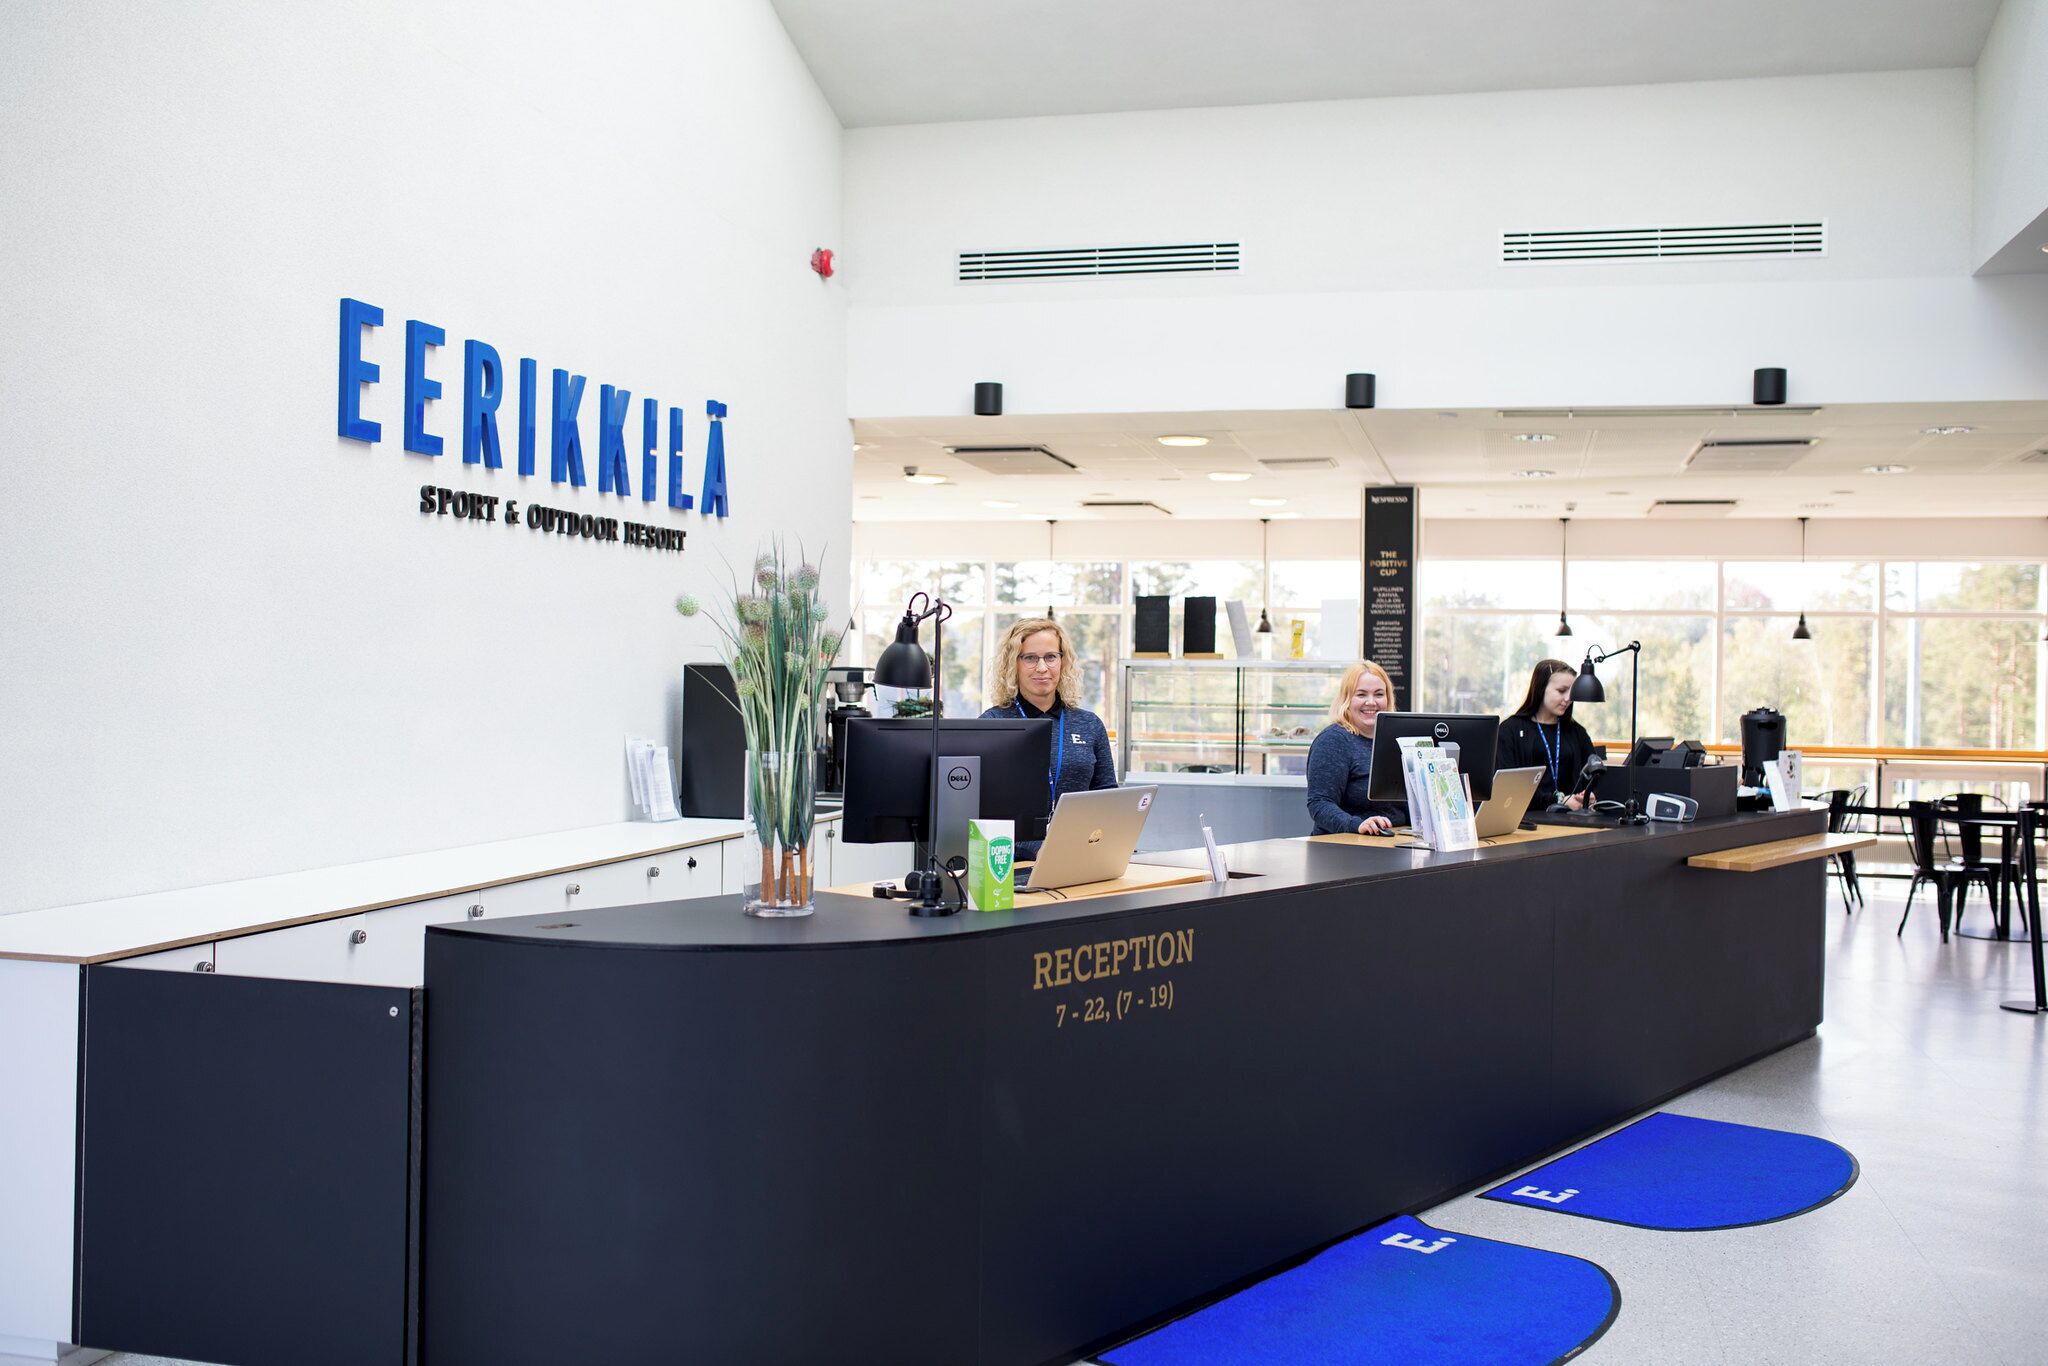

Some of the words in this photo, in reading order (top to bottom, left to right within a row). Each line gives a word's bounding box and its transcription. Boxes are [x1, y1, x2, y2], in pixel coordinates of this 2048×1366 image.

[338, 297, 729, 517] EERIKKILÄ
[1371, 496, 1408, 504] NESPRESSO
[420, 485, 499, 522] SPORT
[505, 500, 520, 524] &
[527, 503, 619, 543] OUTDOOR
[623, 521, 687, 551] RESORT
[1380, 551, 1397, 559] THE
[991, 845, 1011, 856] DOPING
[995, 855, 1007, 865] FREE
[1033, 928, 1194, 990] RECEPTION
[1056, 1004, 1067, 1028] 7
[1084, 996, 1110, 1023] 22,
[1116, 990, 1133, 1020] (7
[1150, 980, 1174, 1010] 19)
